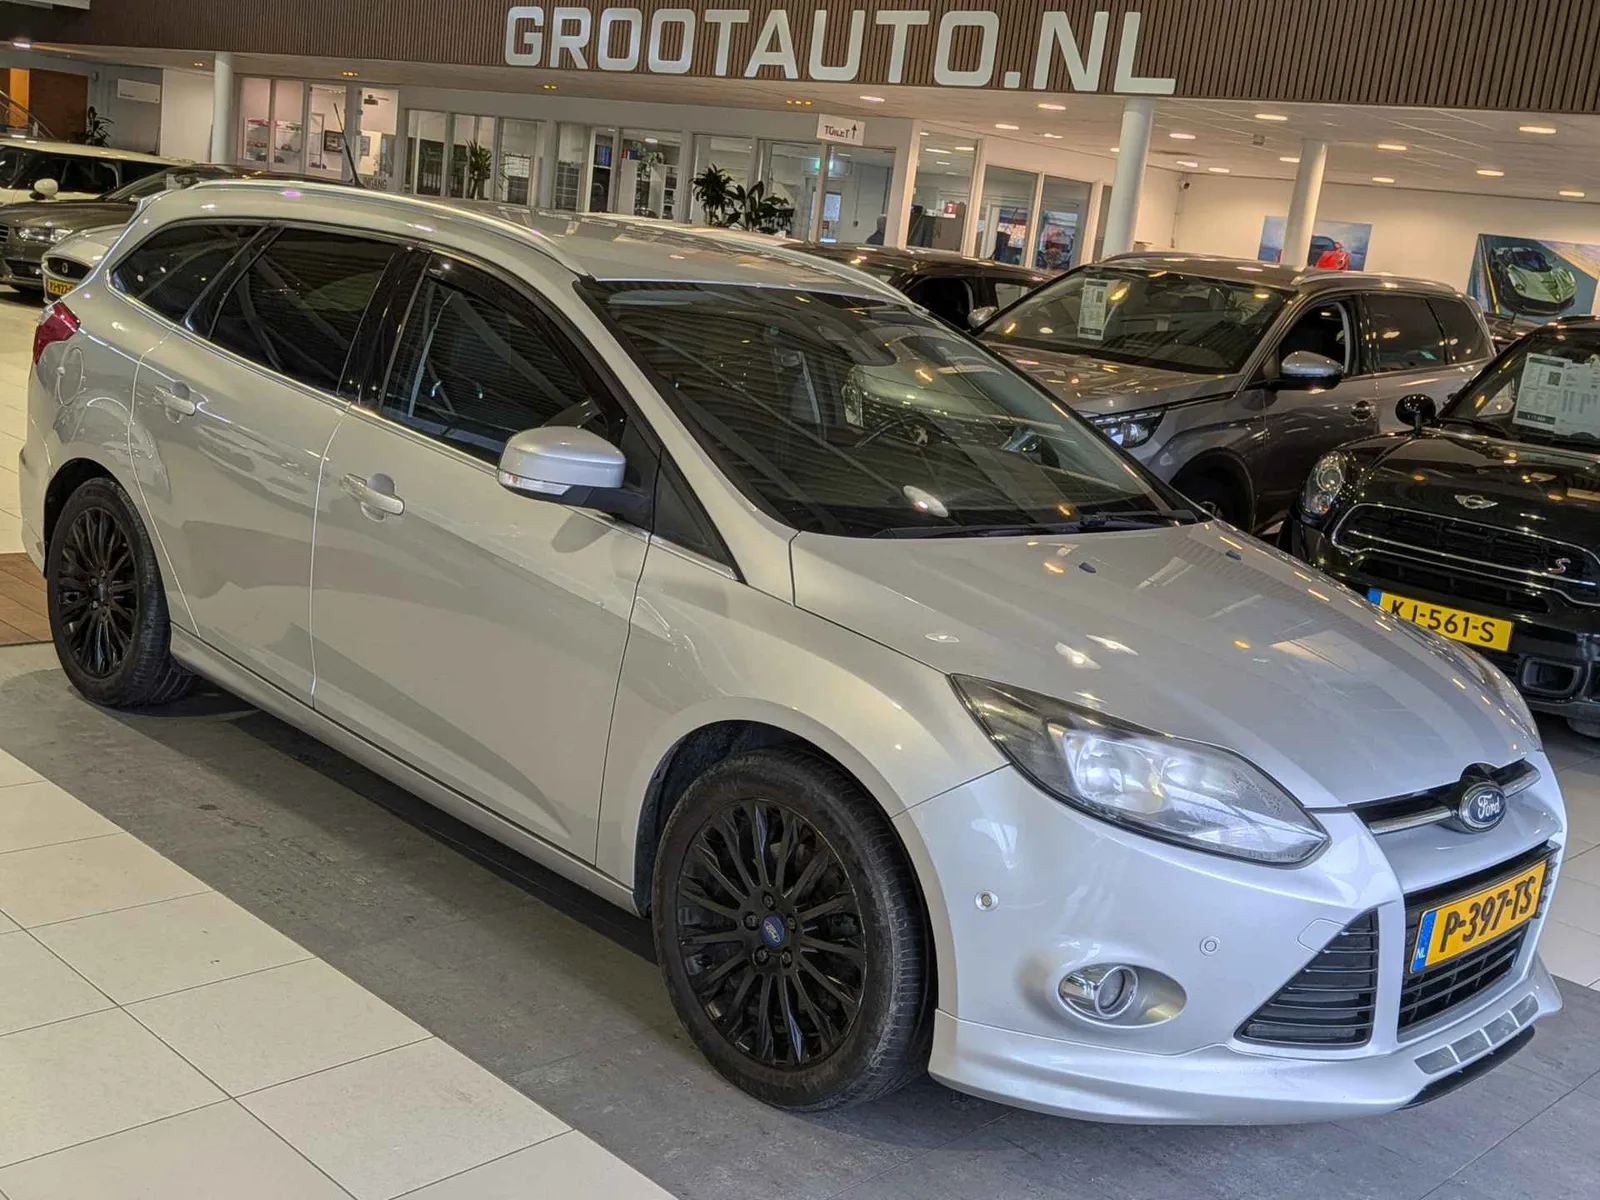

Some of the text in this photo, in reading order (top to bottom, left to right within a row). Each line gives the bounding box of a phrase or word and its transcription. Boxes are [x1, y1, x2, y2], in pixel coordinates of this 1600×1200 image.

[504, 6, 1176, 94] GROOTAUTO.NL
[1477, 794, 1500, 820] Ford
[1439, 876, 1536, 953] P-397-TS
[1415, 946, 1425, 961] NL
